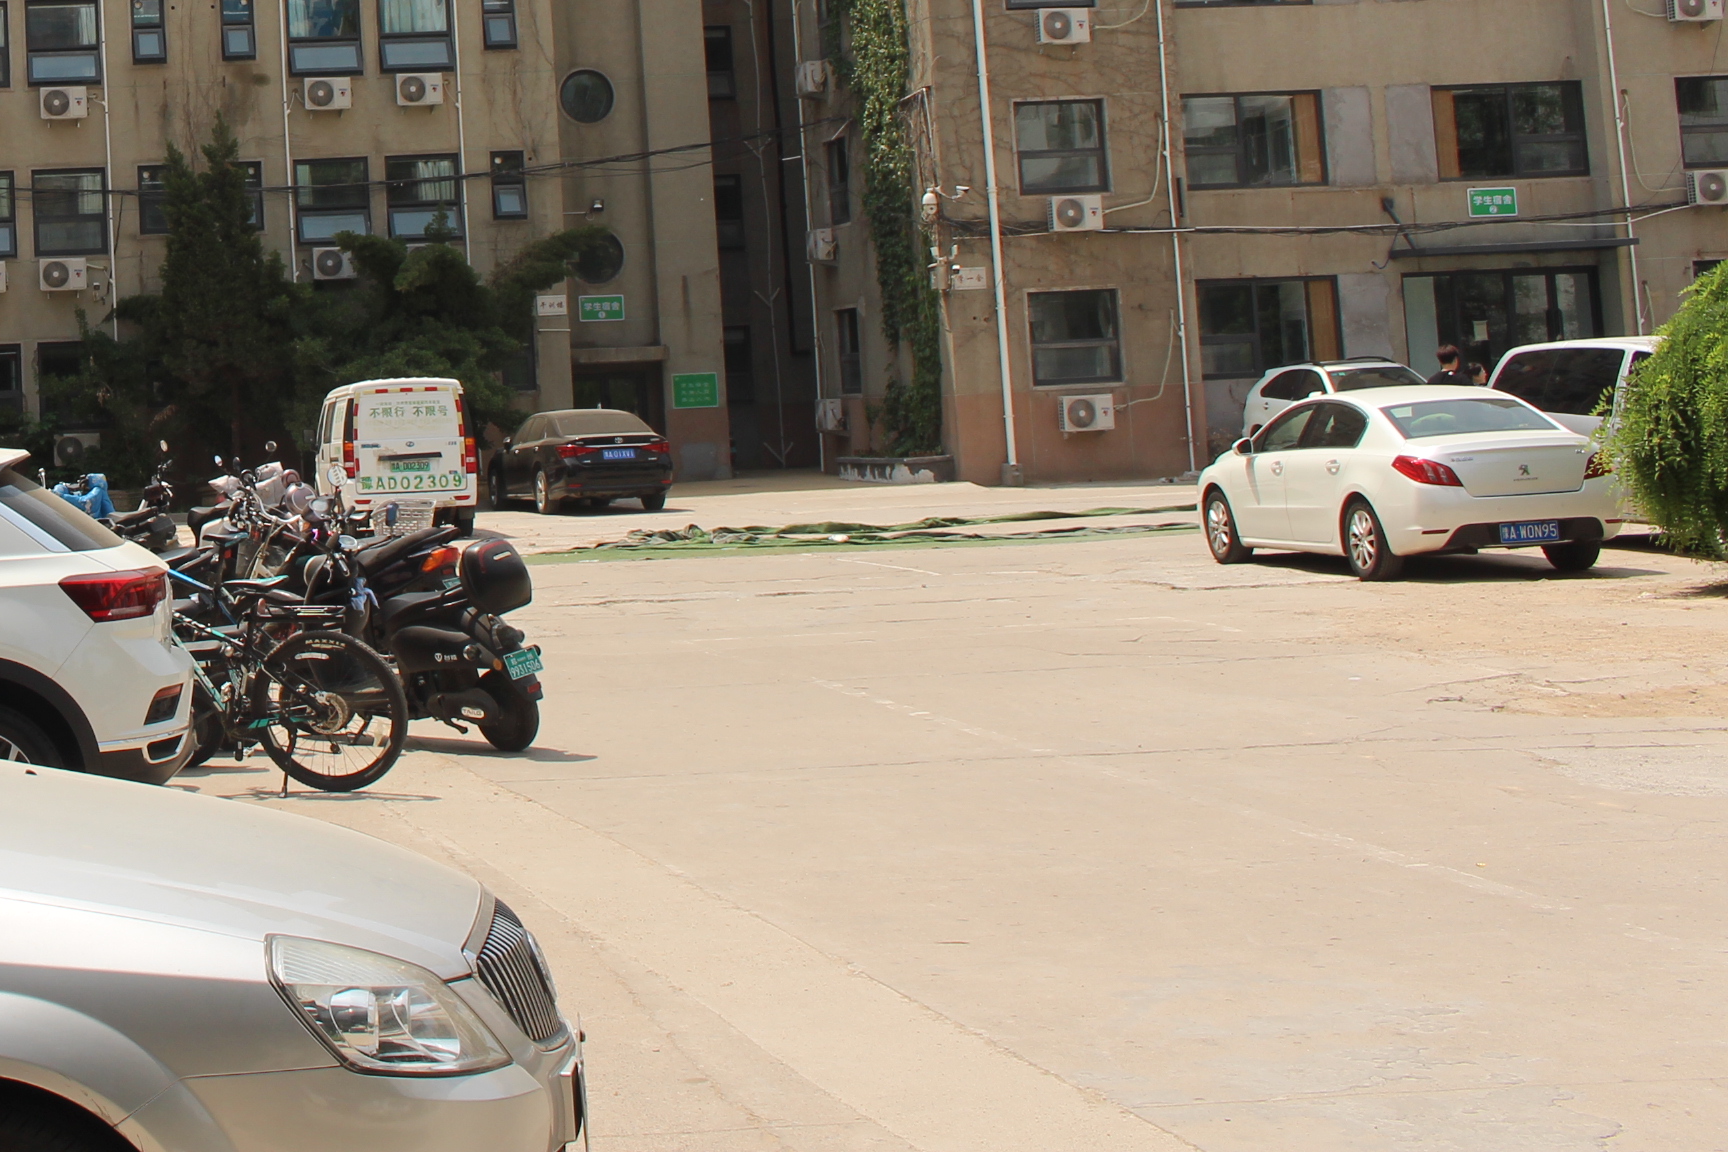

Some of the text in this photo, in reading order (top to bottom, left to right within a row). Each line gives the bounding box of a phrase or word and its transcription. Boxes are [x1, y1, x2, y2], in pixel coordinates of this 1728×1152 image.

[1473, 194, 1512, 206] 学生宿舍
[584, 301, 620, 311] 学生宿舍
[369, 405, 448, 418] 不限行 不限号
